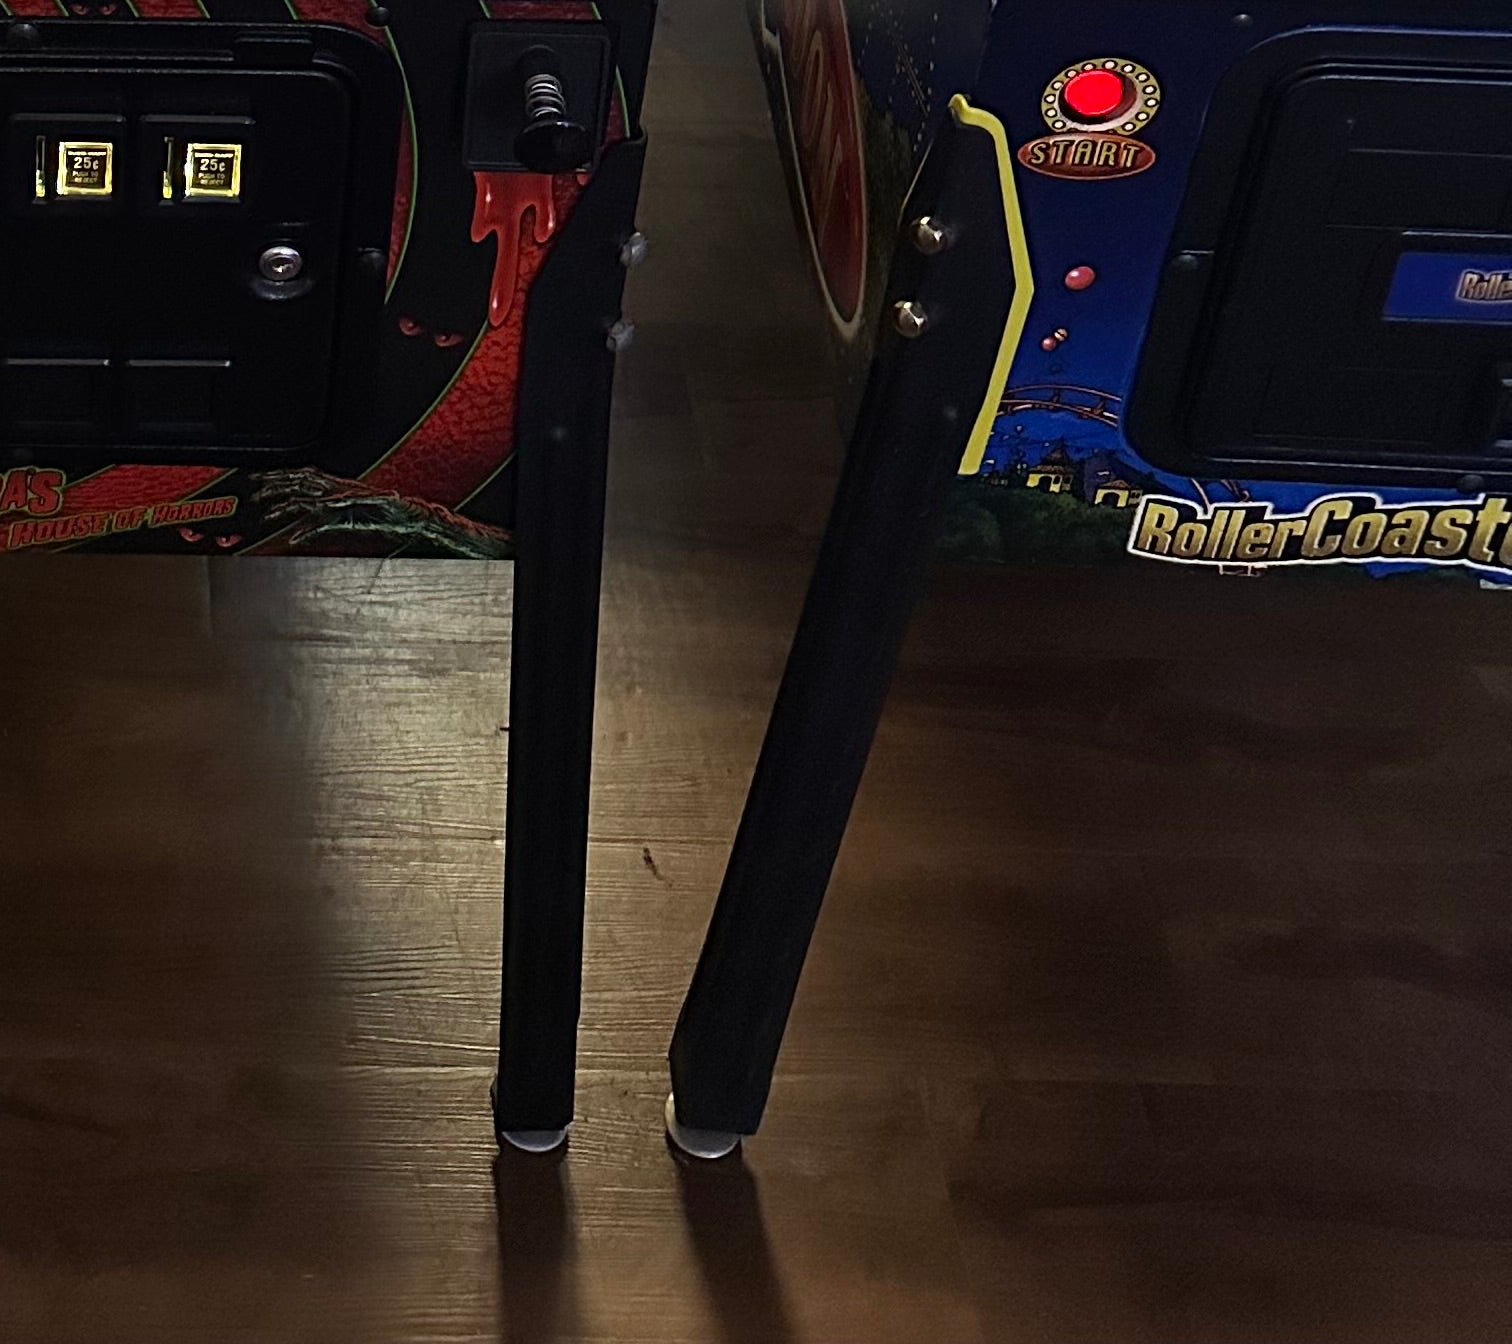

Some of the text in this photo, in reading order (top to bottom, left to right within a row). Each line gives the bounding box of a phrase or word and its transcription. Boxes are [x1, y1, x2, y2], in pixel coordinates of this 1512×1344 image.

[73, 156, 100, 170] 25¢
[199, 158, 226, 172] 25¢
[1028, 139, 1142, 169] START
[9, 496, 239, 550] HOUSE OF HORRORS
[1137, 497, 1512, 563] RollerCoast
